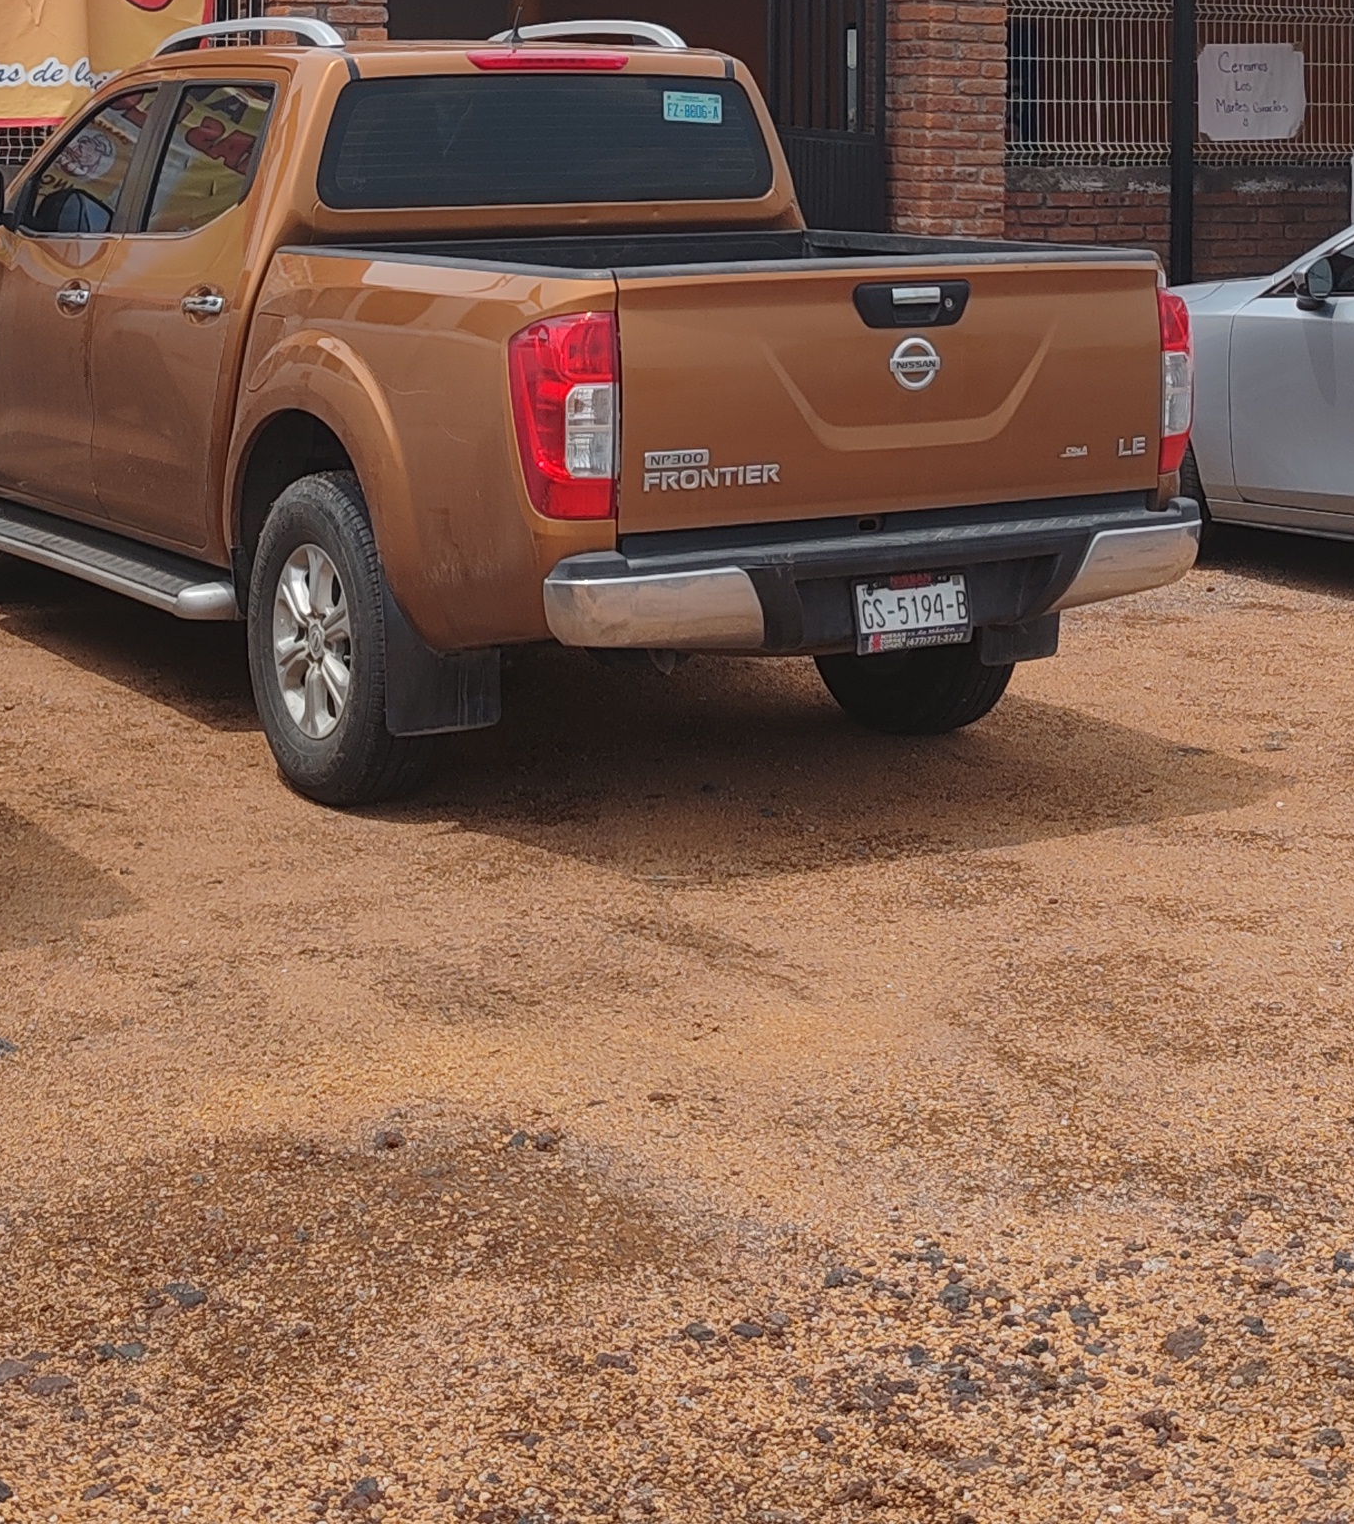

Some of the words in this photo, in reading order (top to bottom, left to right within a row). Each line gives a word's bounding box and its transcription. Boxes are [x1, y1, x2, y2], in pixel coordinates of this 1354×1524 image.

[33, 60, 63, 83] de
[1234, 80, 1253, 93] Los
[1215, 97, 1250, 114] Martes
[896, 359, 937, 369] NISSAN
[1117, 436, 1146, 457] LE
[650, 452, 704, 466] NP300
[643, 463, 781, 493] FRONTIER
[862, 590, 968, 630] GS-5194-B
